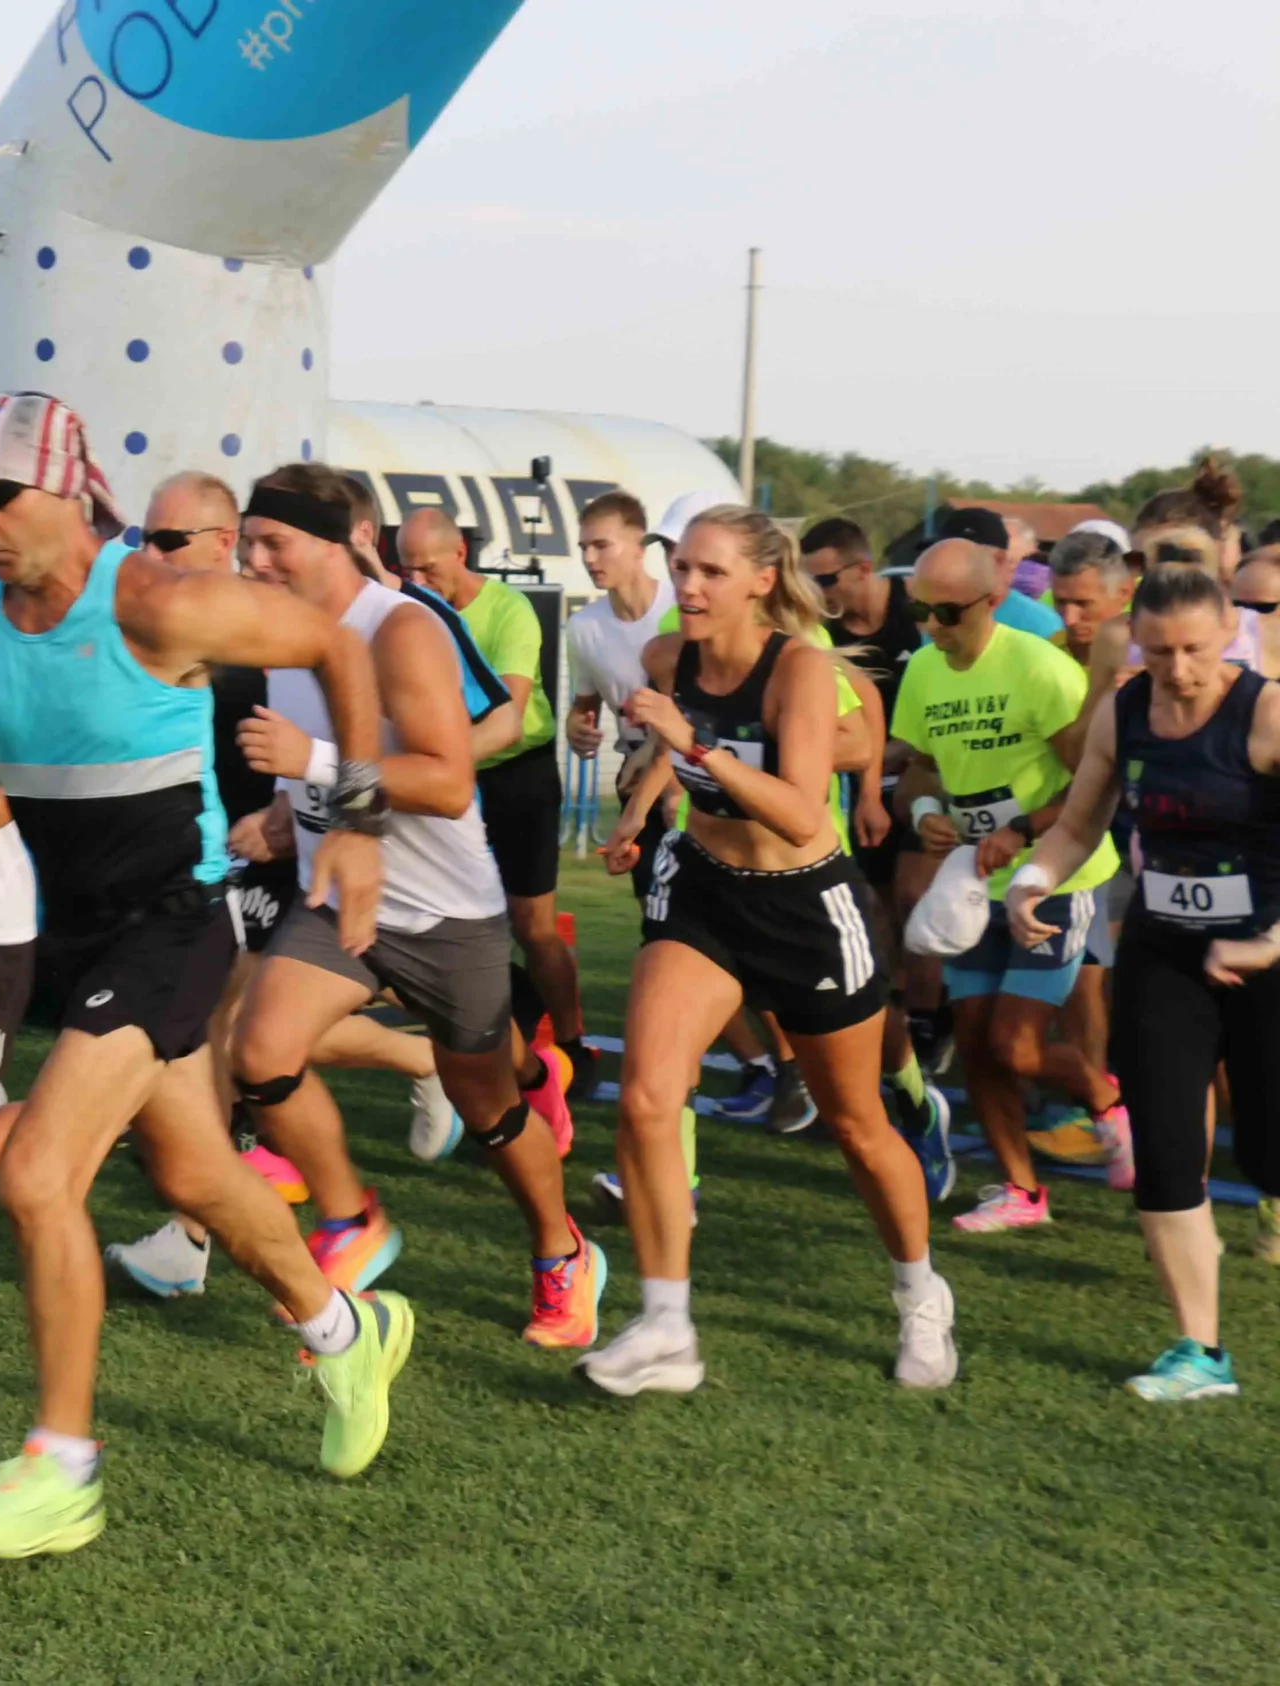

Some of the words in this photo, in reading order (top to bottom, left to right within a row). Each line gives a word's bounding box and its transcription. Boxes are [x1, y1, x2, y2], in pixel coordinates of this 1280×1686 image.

[928, 717, 1004, 738] running
[962, 809, 996, 834] 29
[1170, 882, 1214, 911] 40
